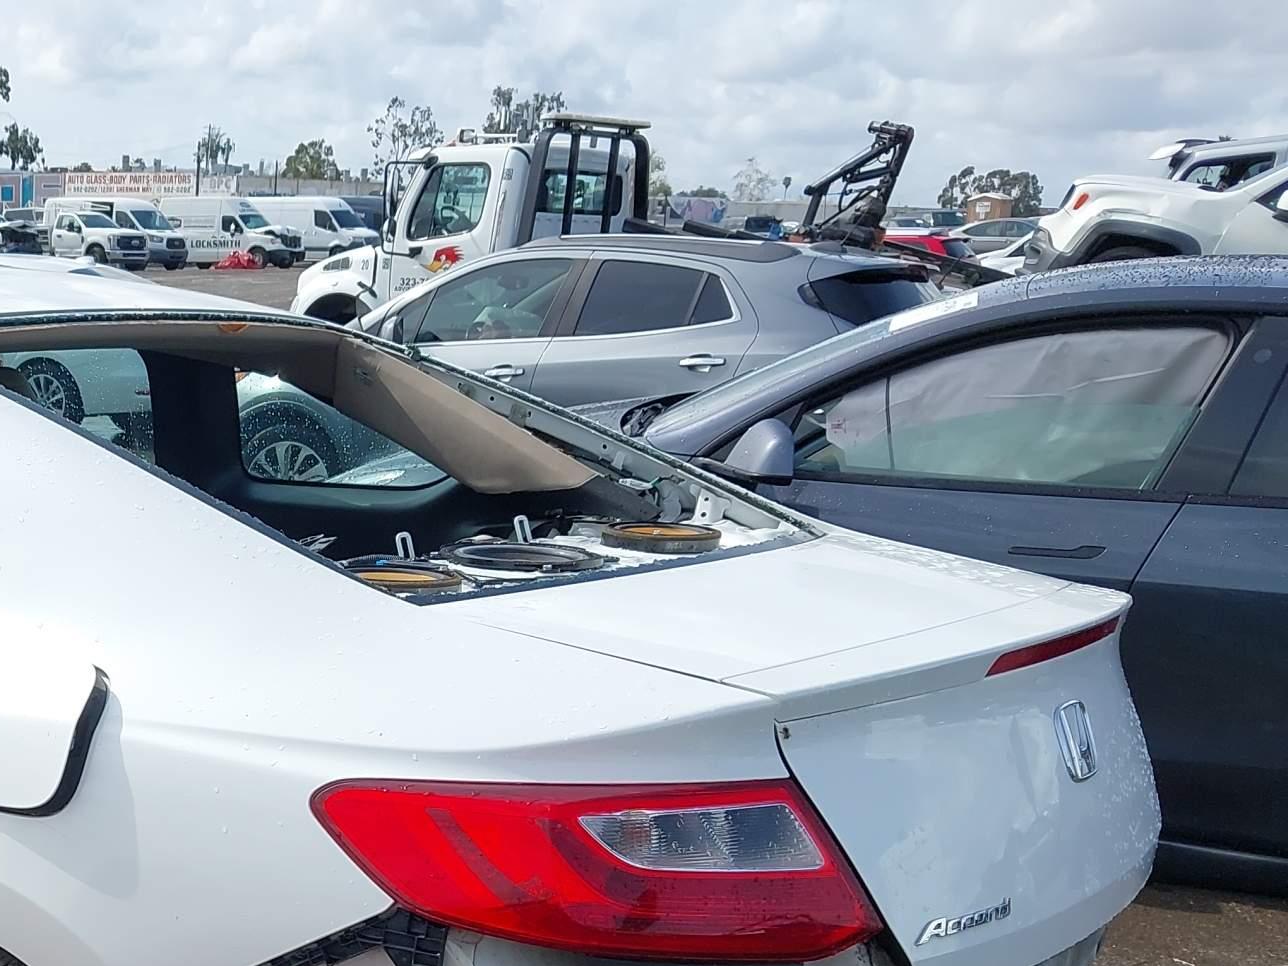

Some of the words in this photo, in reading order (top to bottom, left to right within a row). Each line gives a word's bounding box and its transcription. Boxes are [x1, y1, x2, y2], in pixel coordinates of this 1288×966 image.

[67, 175, 84, 185] AUTO
[190, 239, 241, 249] LOCKSMITH
[914, 897, 1012, 947] Accord
